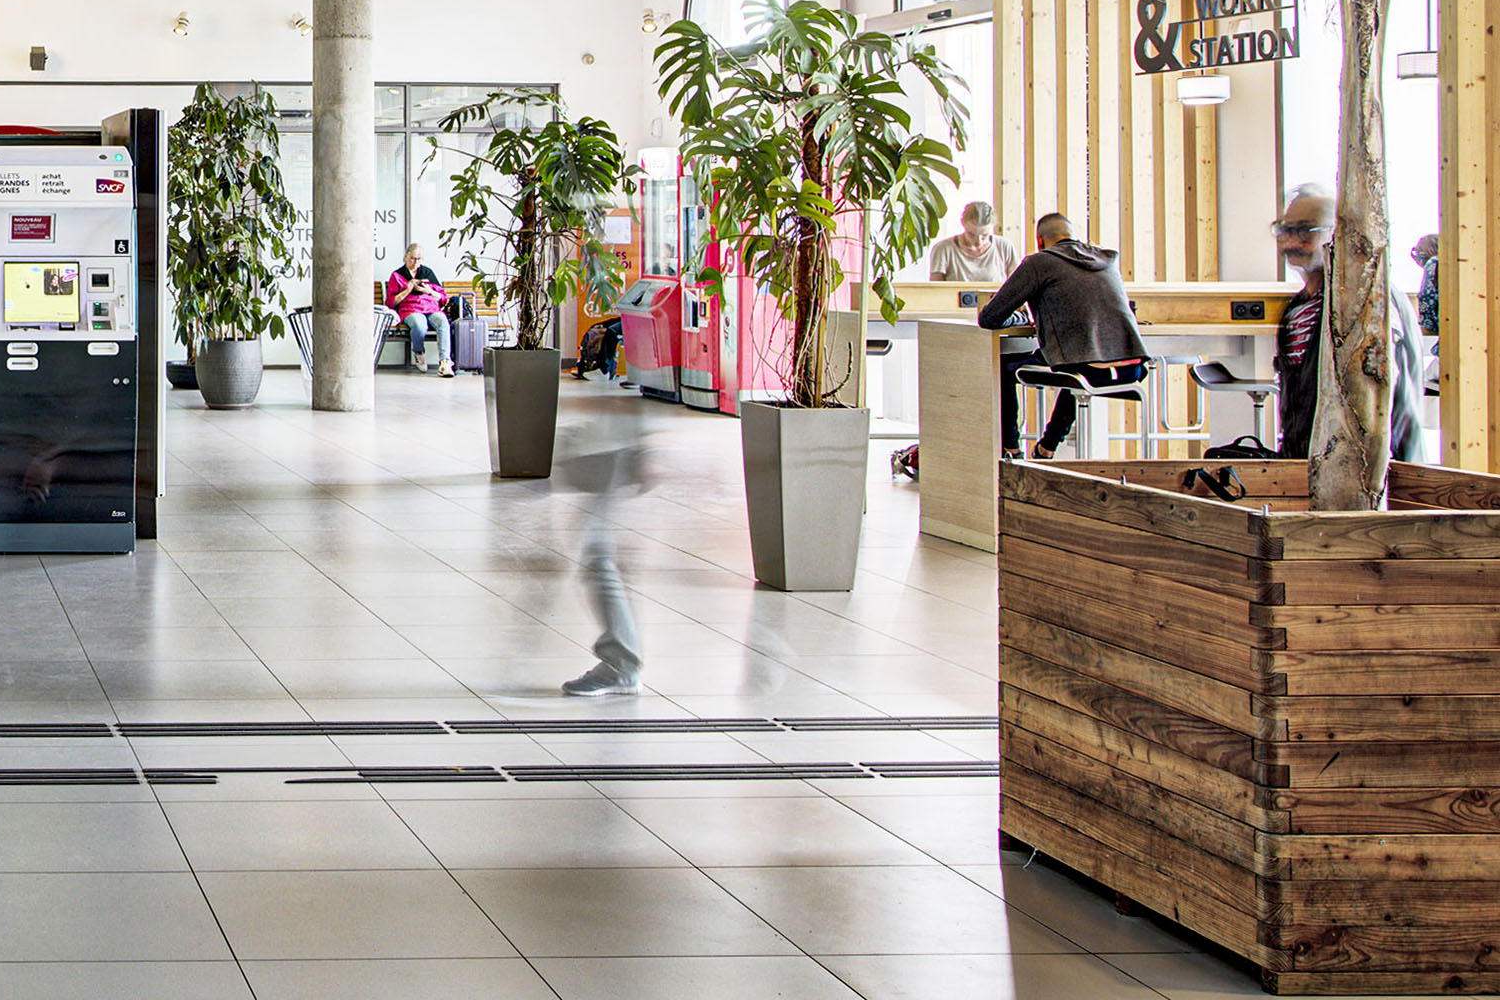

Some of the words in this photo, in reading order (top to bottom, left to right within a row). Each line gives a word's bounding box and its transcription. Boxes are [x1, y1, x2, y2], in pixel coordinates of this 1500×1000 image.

[1189, 26, 1299, 68] STATION
[42, 187, 71, 195] échange
[97, 183, 124, 192] SNCF
